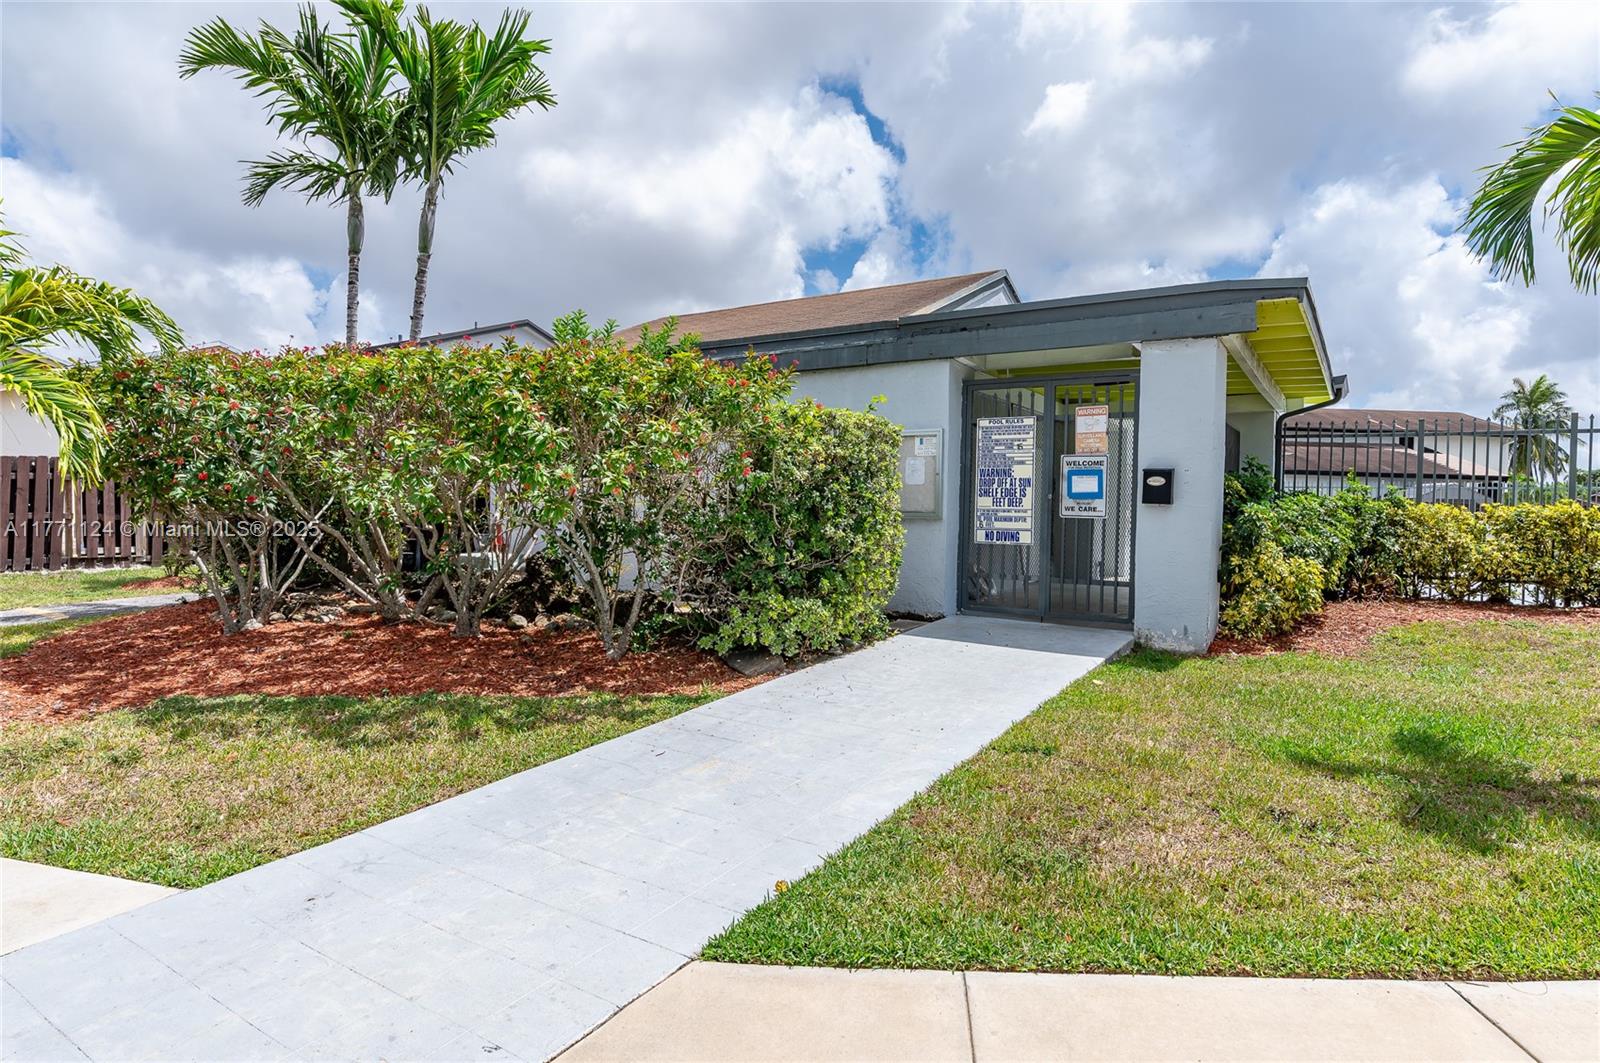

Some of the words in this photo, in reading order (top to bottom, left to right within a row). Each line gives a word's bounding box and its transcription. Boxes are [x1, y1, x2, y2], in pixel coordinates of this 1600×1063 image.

[979, 468, 1015, 478] WARNING:
[978, 478, 995, 488] DROP
[997, 478, 1008, 488] OFF
[1010, 478, 1017, 487] AT
[1018, 478, 1032, 487] SUN
[978, 488, 999, 498] SHELF
[1000, 488, 1018, 498] EDGE
[1019, 488, 1027, 497] IS
[992, 498, 1006, 507] FEET
[1007, 498, 1024, 507] DEEP.
[984, 531, 995, 541] NO
[996, 531, 1020, 542] DIVING
